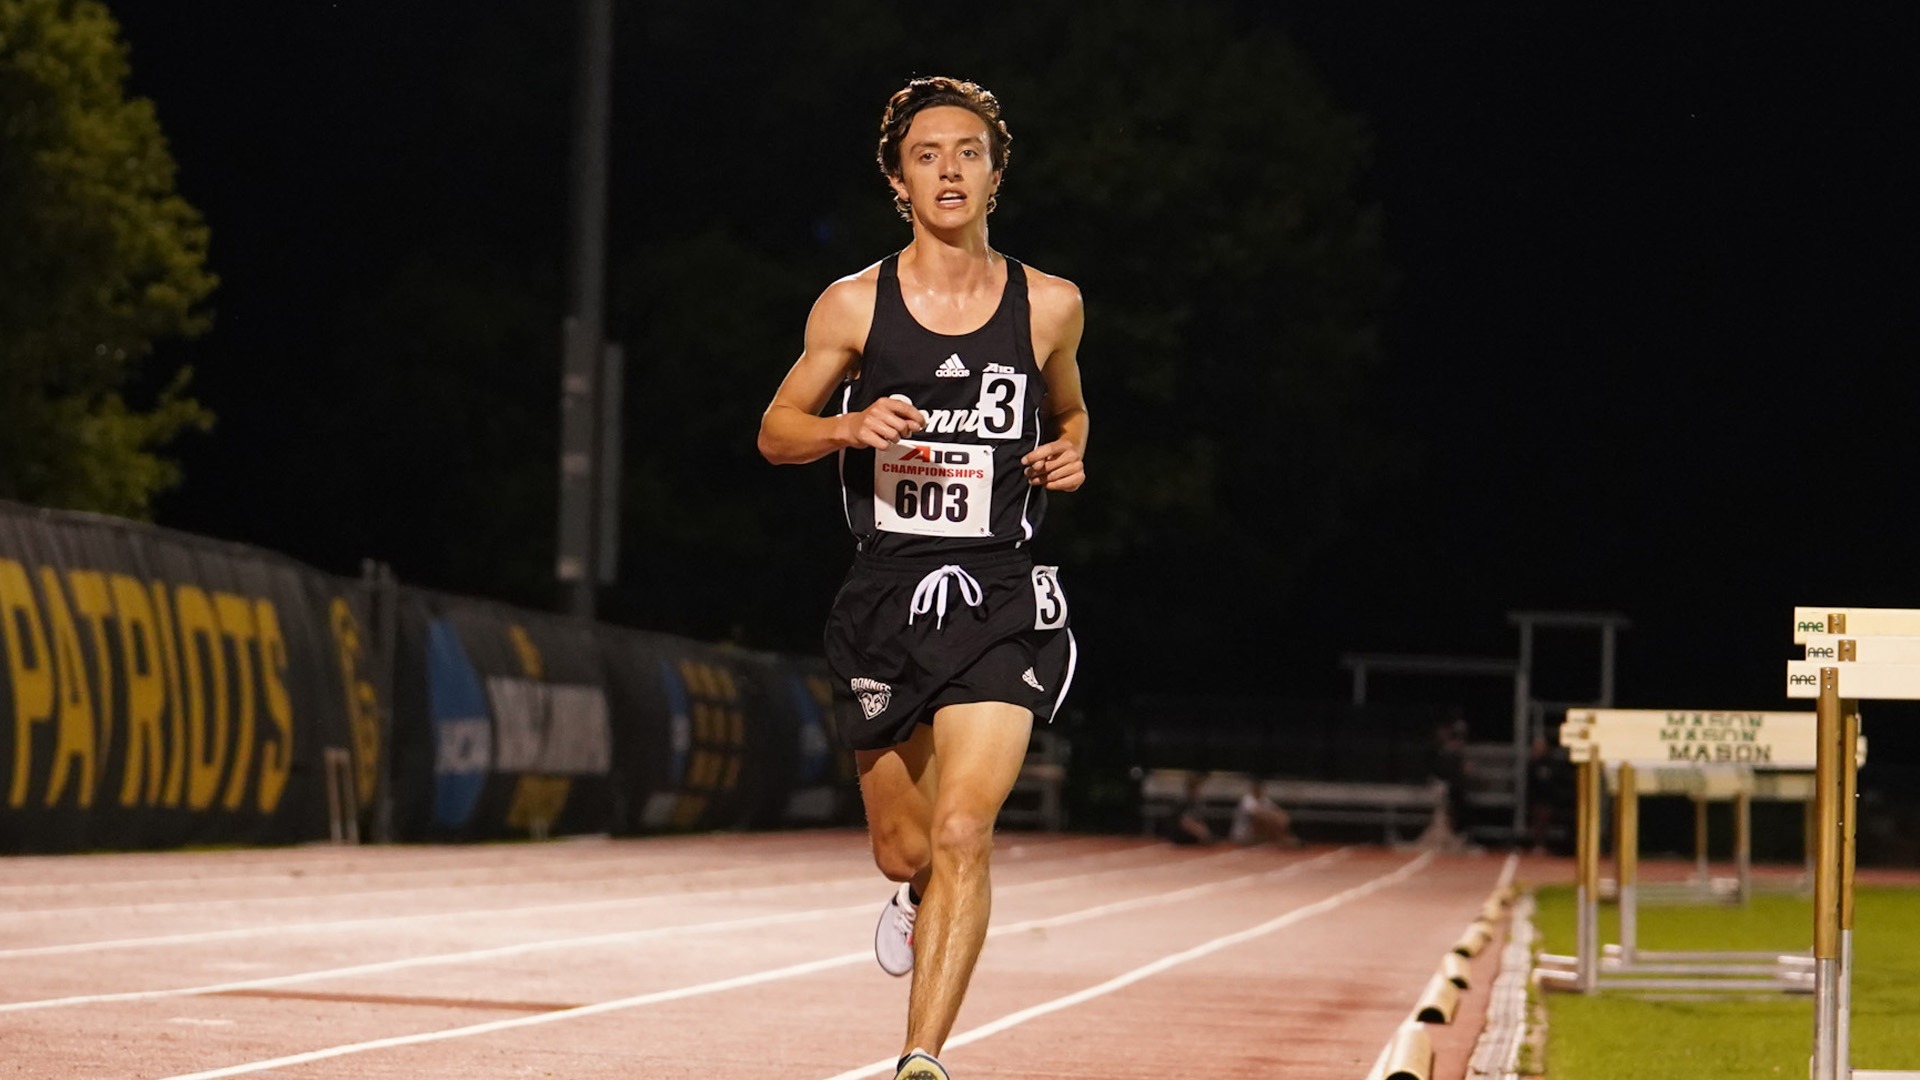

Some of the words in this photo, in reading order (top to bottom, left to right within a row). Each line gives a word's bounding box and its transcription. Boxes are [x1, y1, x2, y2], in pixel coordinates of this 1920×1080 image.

[935, 369, 970, 377] adidas
[984, 378, 1016, 433] 3
[899, 446, 970, 465] A10
[882, 463, 984, 479] CHAMPIONSHIPS
[895, 480, 969, 522] 603
[1036, 570, 1061, 625] 3
[0, 556, 293, 814] PATRIOTS
[851, 677, 892, 697] BONNIES
[1668, 743, 1771, 762] MASON
